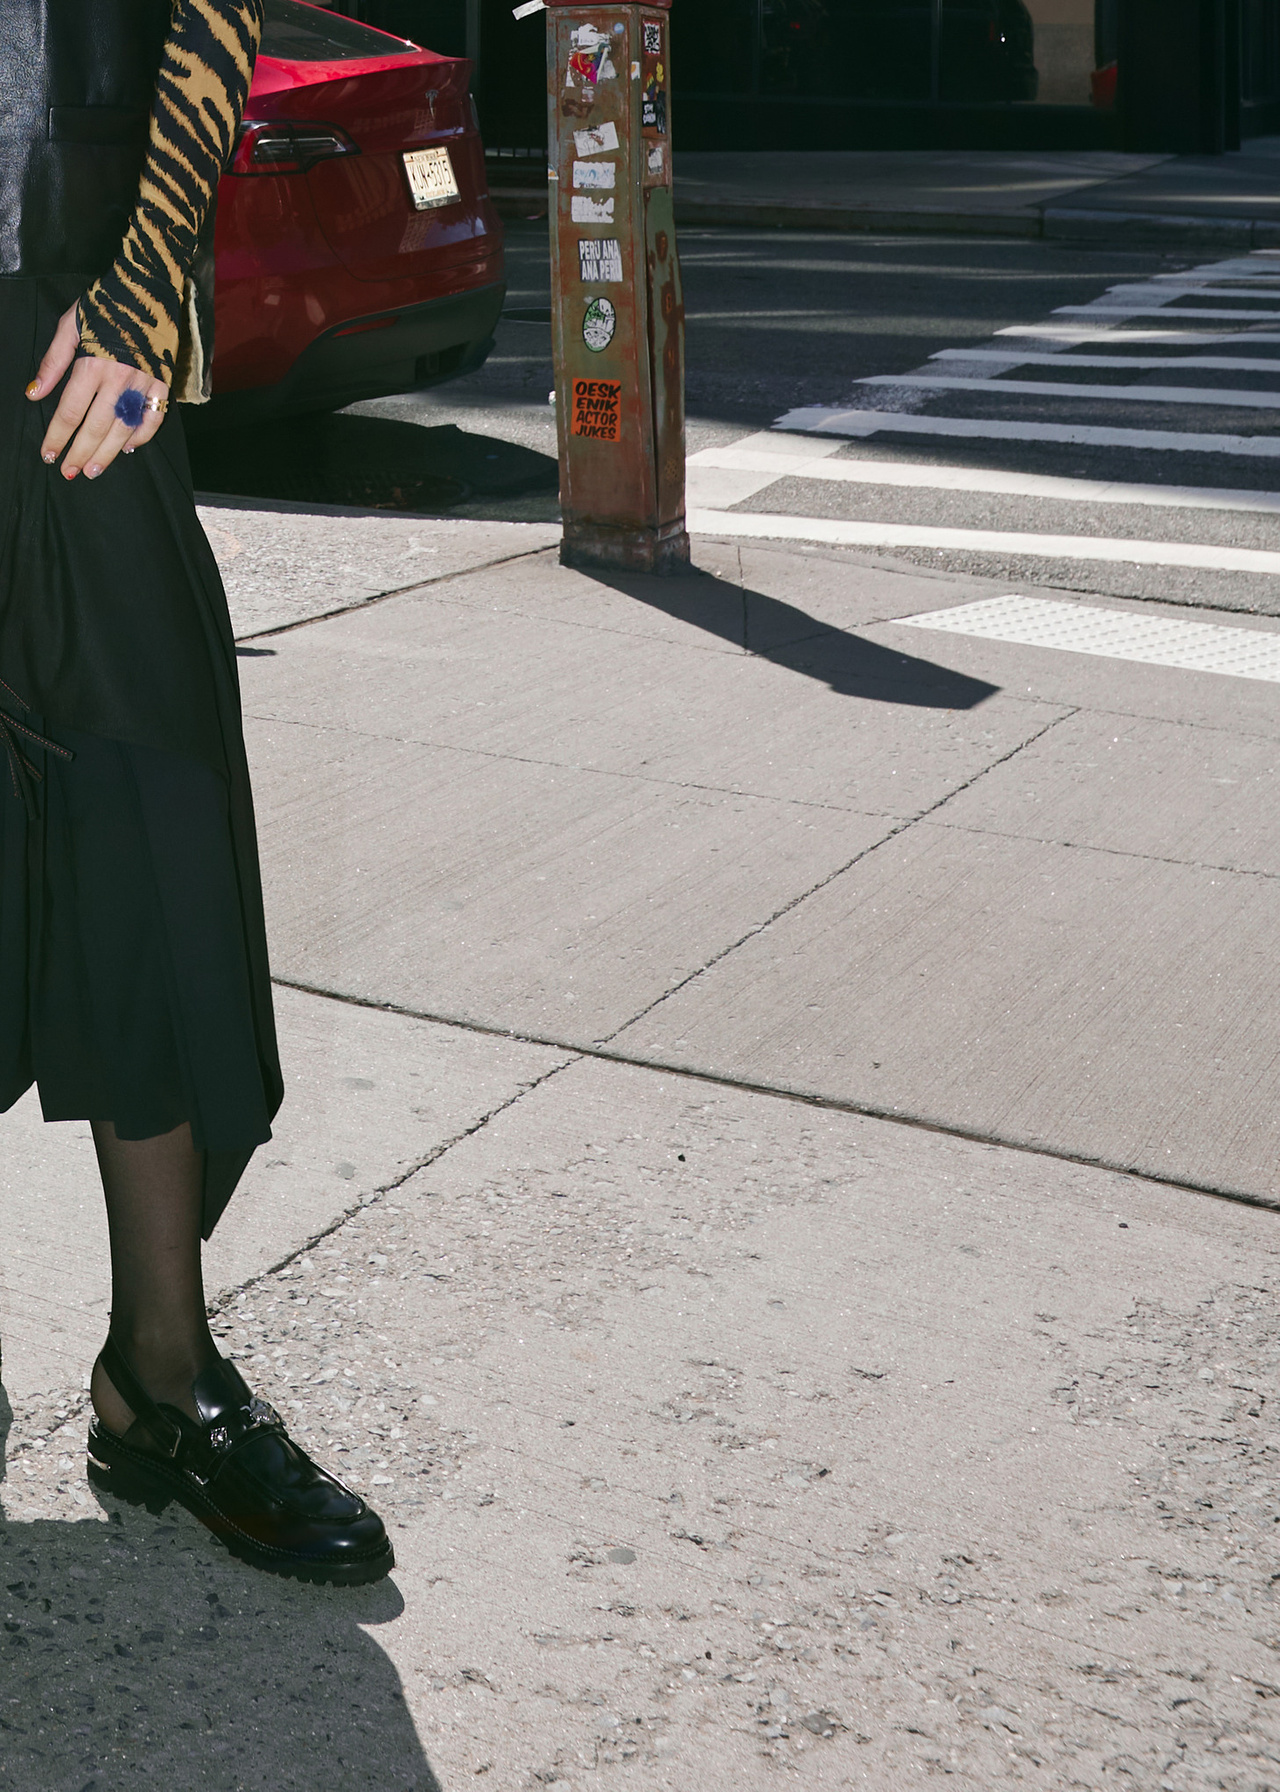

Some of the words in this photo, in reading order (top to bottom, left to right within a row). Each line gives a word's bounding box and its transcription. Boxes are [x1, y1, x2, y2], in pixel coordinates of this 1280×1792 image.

[579, 240, 601, 260] PERU
[602, 239, 619, 260] ANA
[581, 260, 599, 281] ANA
[575, 381, 621, 399] OESK
[576, 397, 618, 412] ENIK
[576, 410, 617, 426] ACTOR
[575, 424, 616, 439] JUKES
